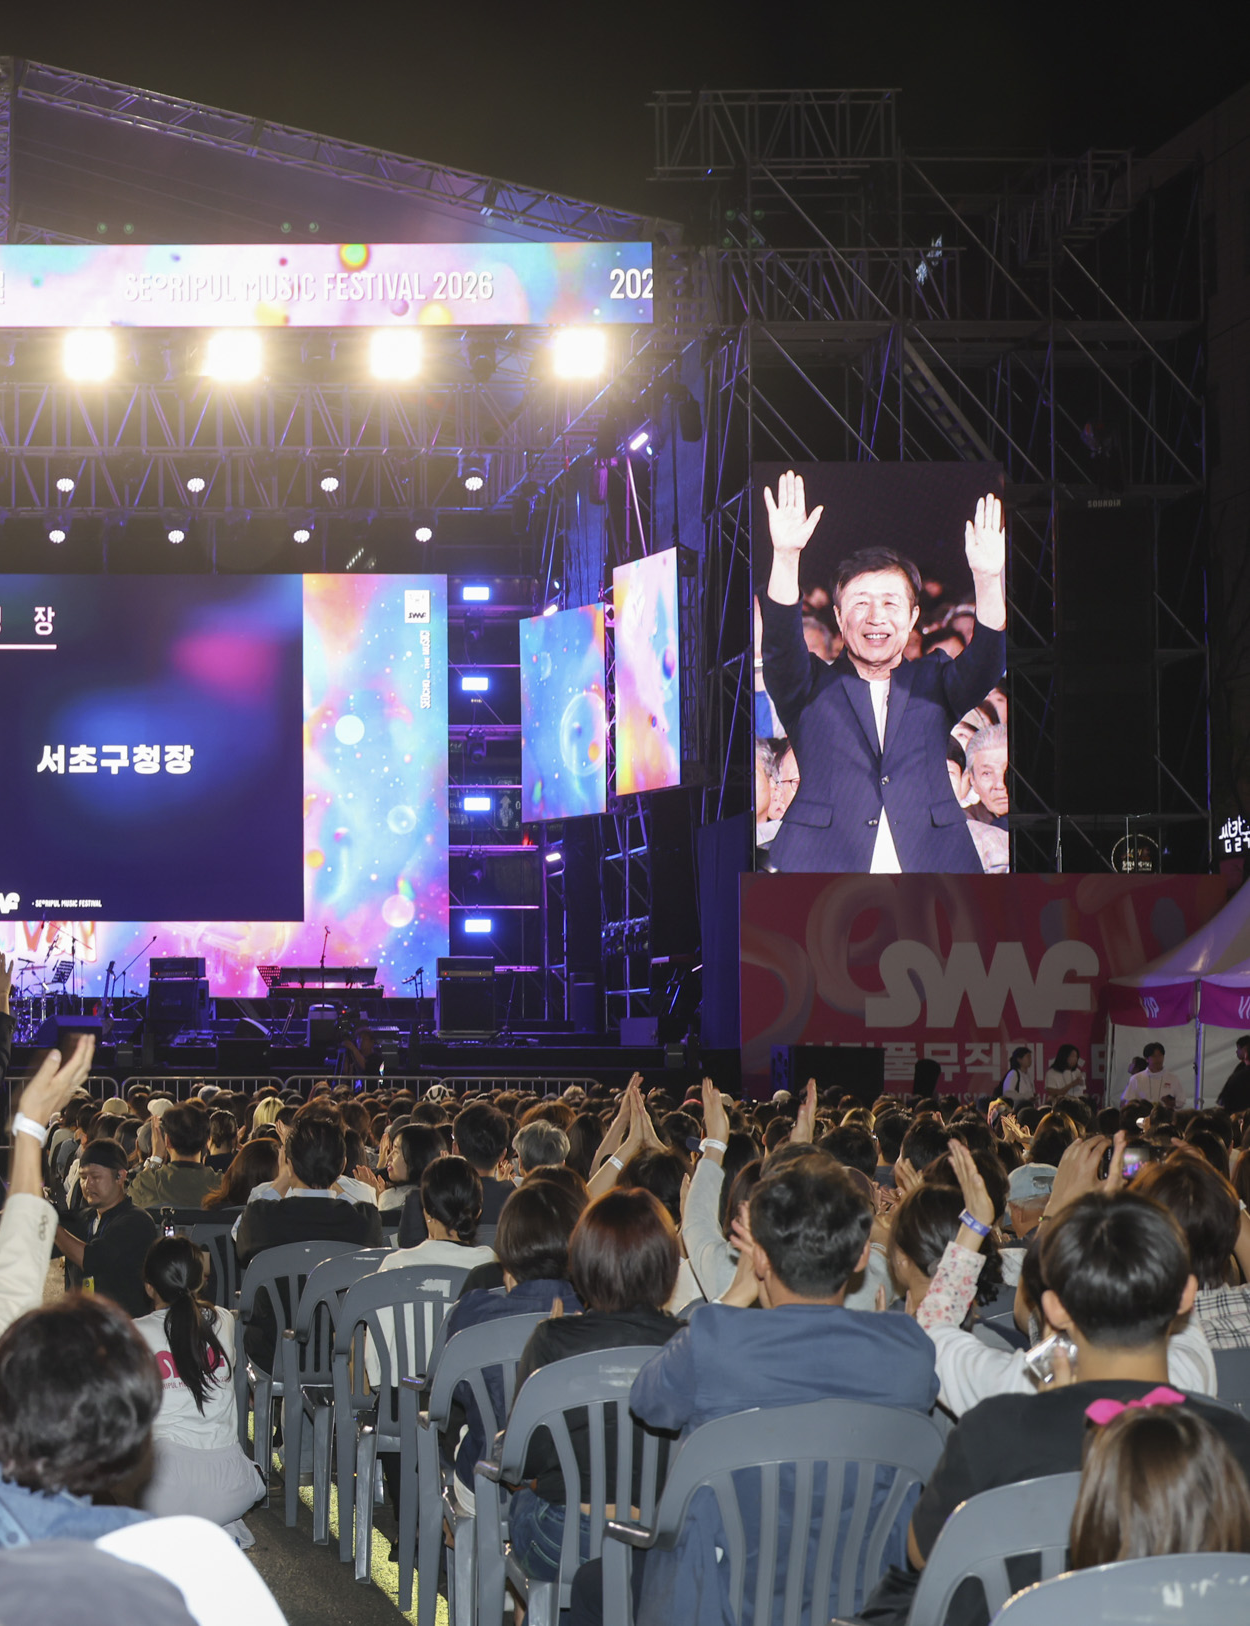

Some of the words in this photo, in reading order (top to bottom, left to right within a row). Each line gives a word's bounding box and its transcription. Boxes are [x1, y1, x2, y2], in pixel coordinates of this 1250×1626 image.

[244, 271, 316, 302] MUSIC
[323, 271, 427, 301] FESTIVAL
[433, 271, 494, 300] 2026
[36, 744, 194, 775] 서초구청장
